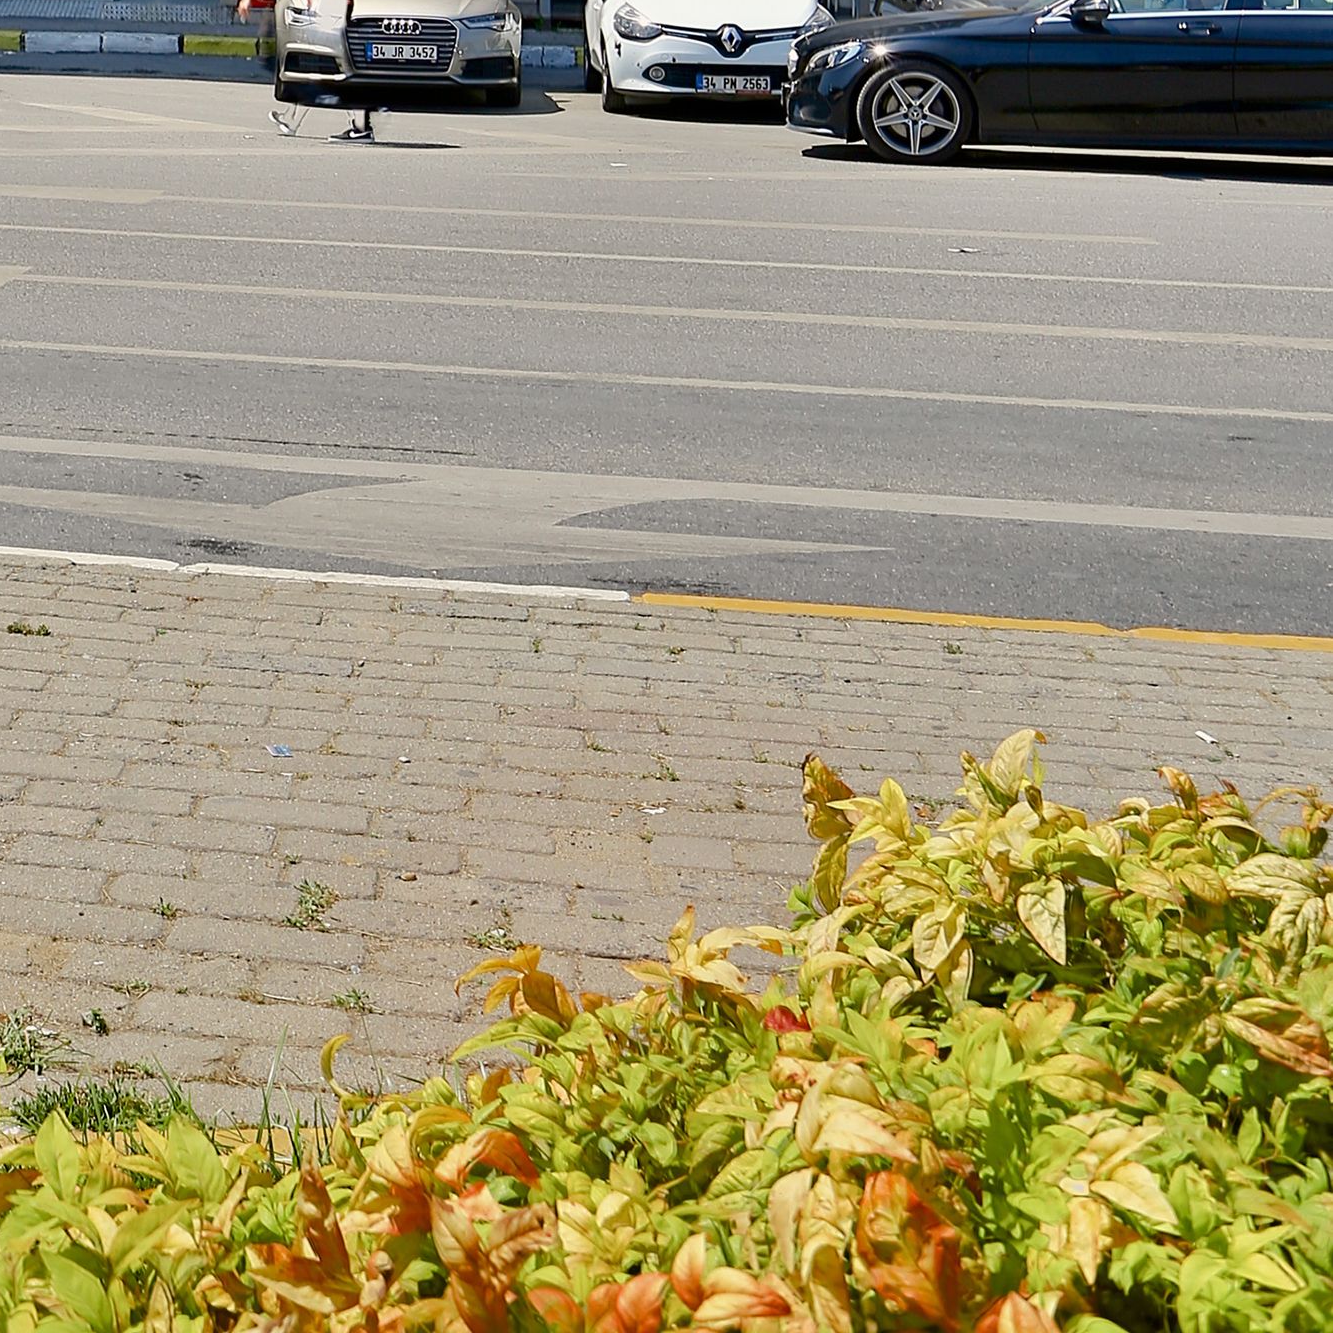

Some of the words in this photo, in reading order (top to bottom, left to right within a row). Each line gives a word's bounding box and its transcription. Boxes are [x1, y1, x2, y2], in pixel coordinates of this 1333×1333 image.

[373, 46, 386, 58] 34
[392, 46, 404, 58] JR
[410, 46, 435, 58] 3452
[703, 77, 716, 89] 34
[742, 77, 769, 90] 2563
